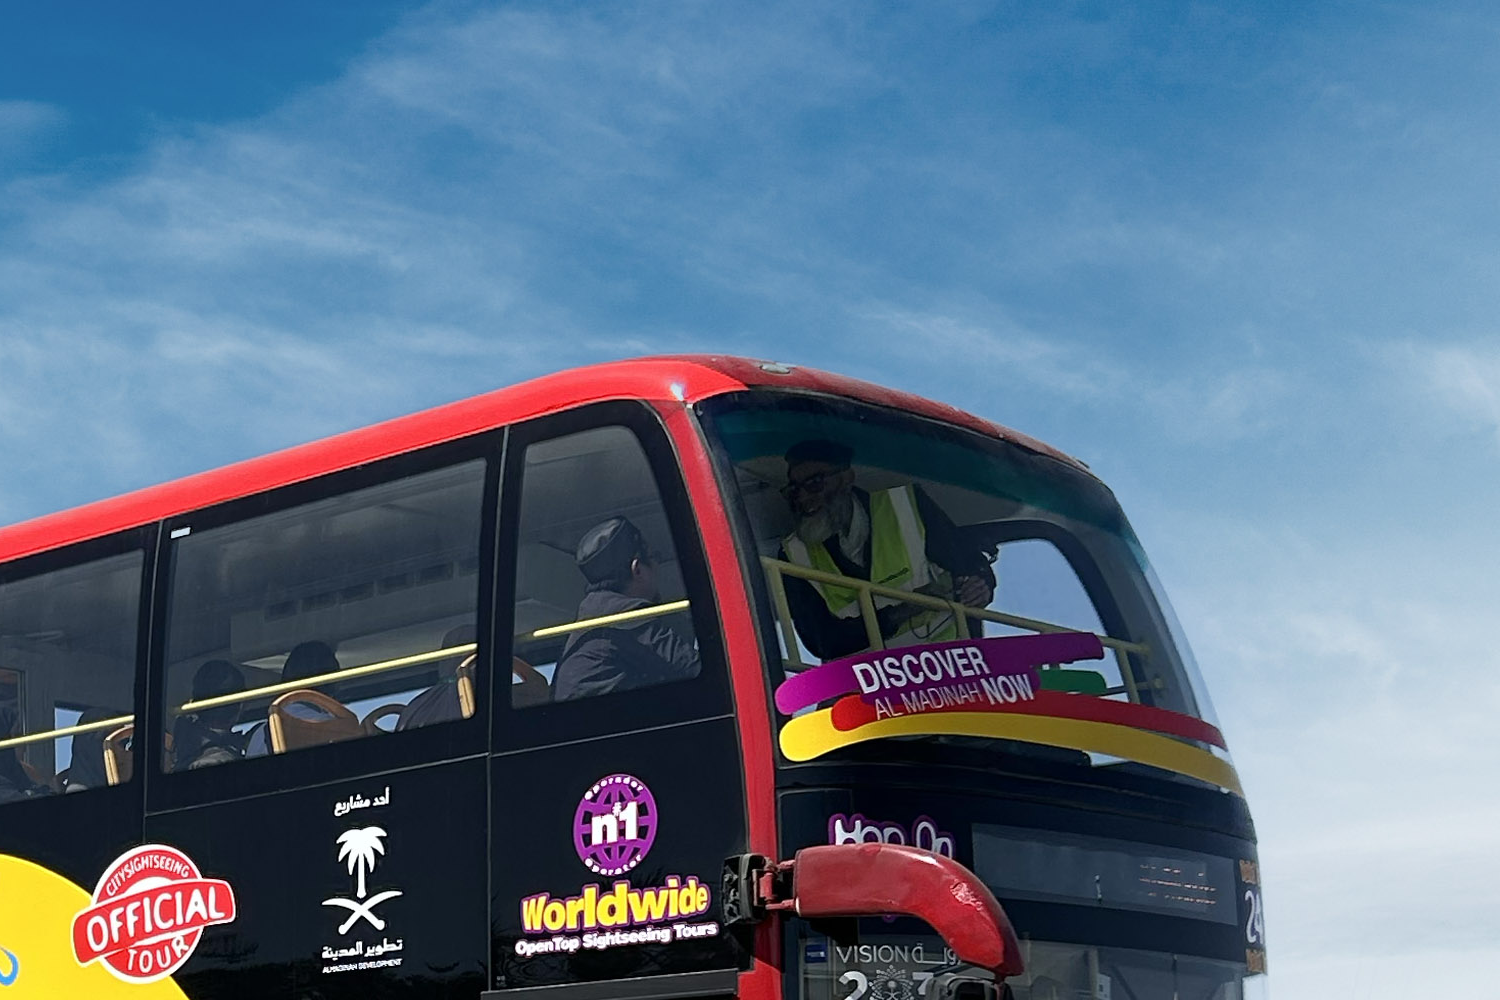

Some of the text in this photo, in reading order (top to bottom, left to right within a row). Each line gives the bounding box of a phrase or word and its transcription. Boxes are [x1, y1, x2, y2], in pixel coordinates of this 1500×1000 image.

[852, 646, 991, 694] DISCOVER
[875, 673, 1035, 720] AL MADINAH NOW
[334, 793, 371, 817] مشاريع
[86, 885, 225, 953] OFFICIAL
[521, 876, 709, 932] Worldwide
[127, 935, 189, 973] TOUR
[321, 937, 403, 961] تطوير المدينة
[582, 926, 671, 950] Sightseeing
[673, 922, 719, 939] Tours
[836, 945, 909, 963] VISION
